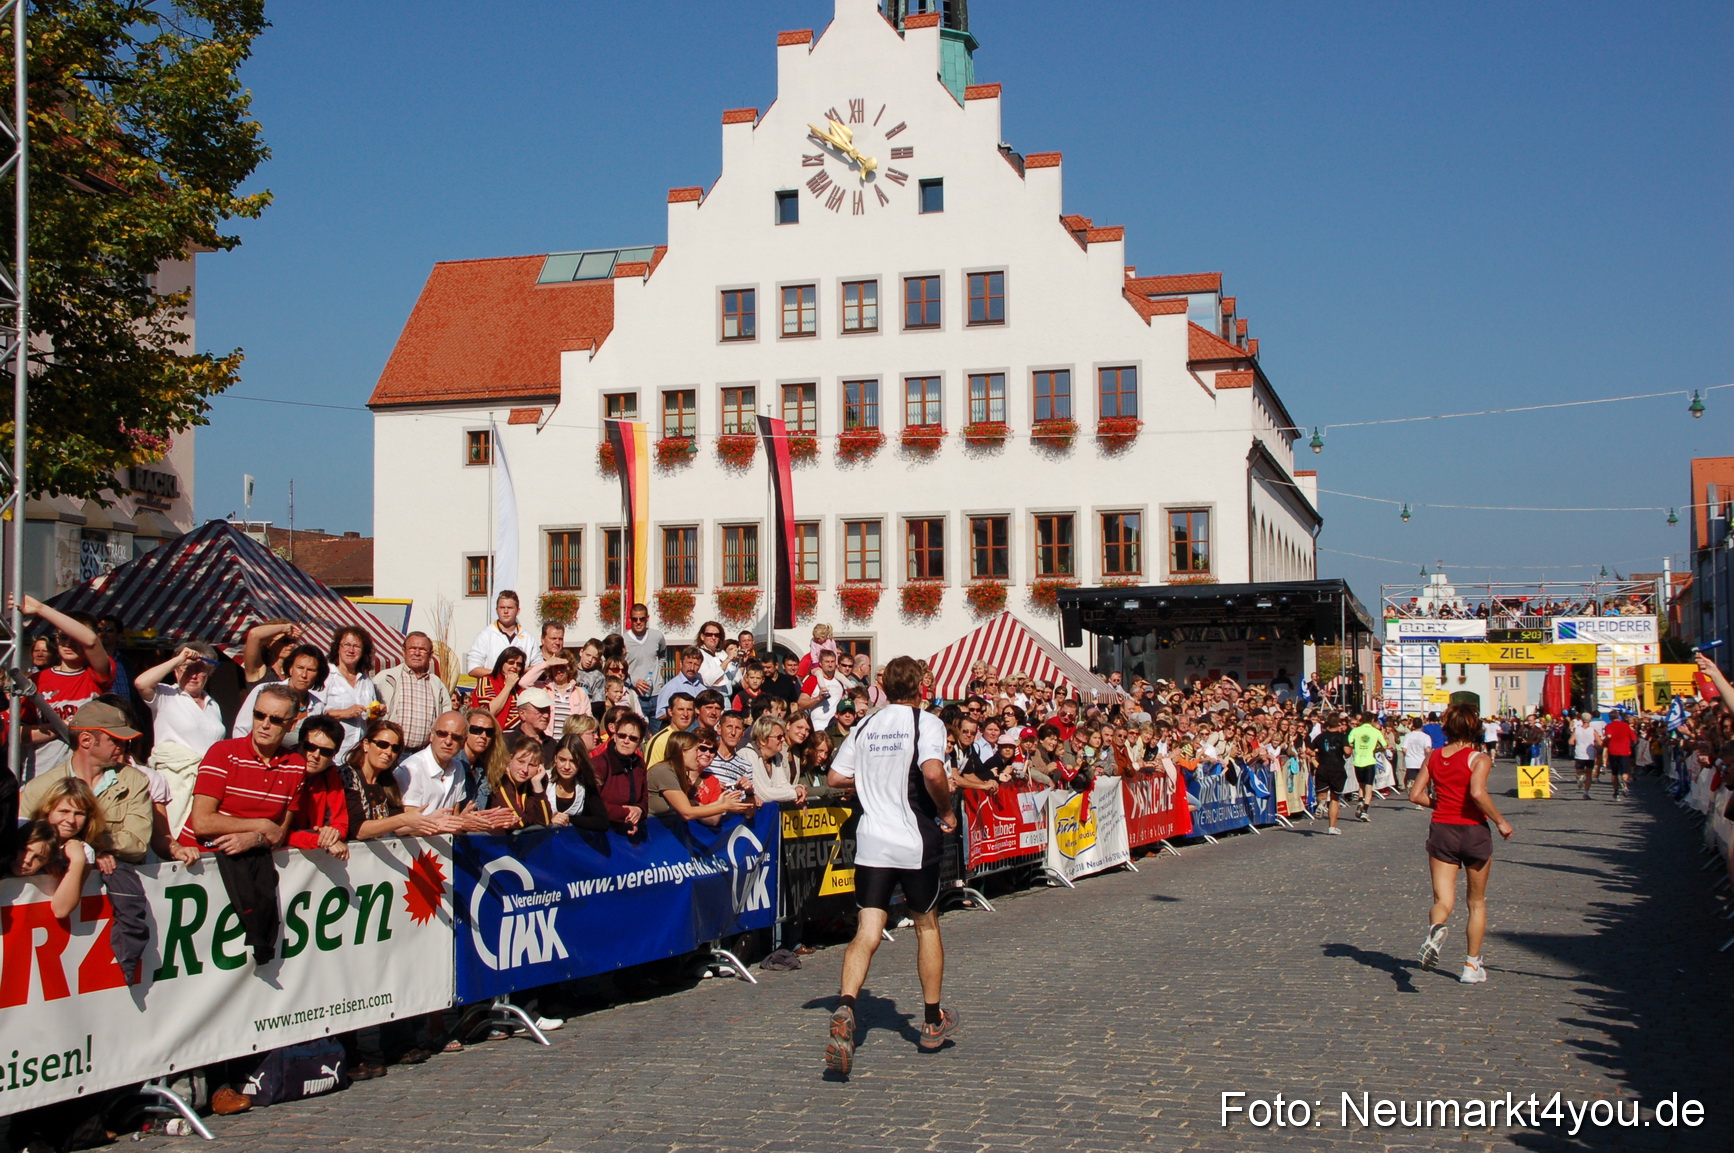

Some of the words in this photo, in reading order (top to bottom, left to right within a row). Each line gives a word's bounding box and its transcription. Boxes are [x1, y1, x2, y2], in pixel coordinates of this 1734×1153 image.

[849, 98, 864, 124] XII
[890, 146, 914, 160] III
[1399, 622, 1448, 633] BOCK
[1578, 620, 1651, 633] PFLEIDERER
[1500, 647, 1535, 660] ZIEL
[1657, 688, 1669, 701] A
[867, 732, 880, 740] Wir
[881, 731, 909, 739] machen
[882, 742, 903, 751] mobil.
[784, 813, 837, 831] HOLZBAU
[511, 890, 561, 909] Vereinigte
[153, 880, 394, 982] Resen
[254, 992, 393, 1032] www.merz-reisen.com
